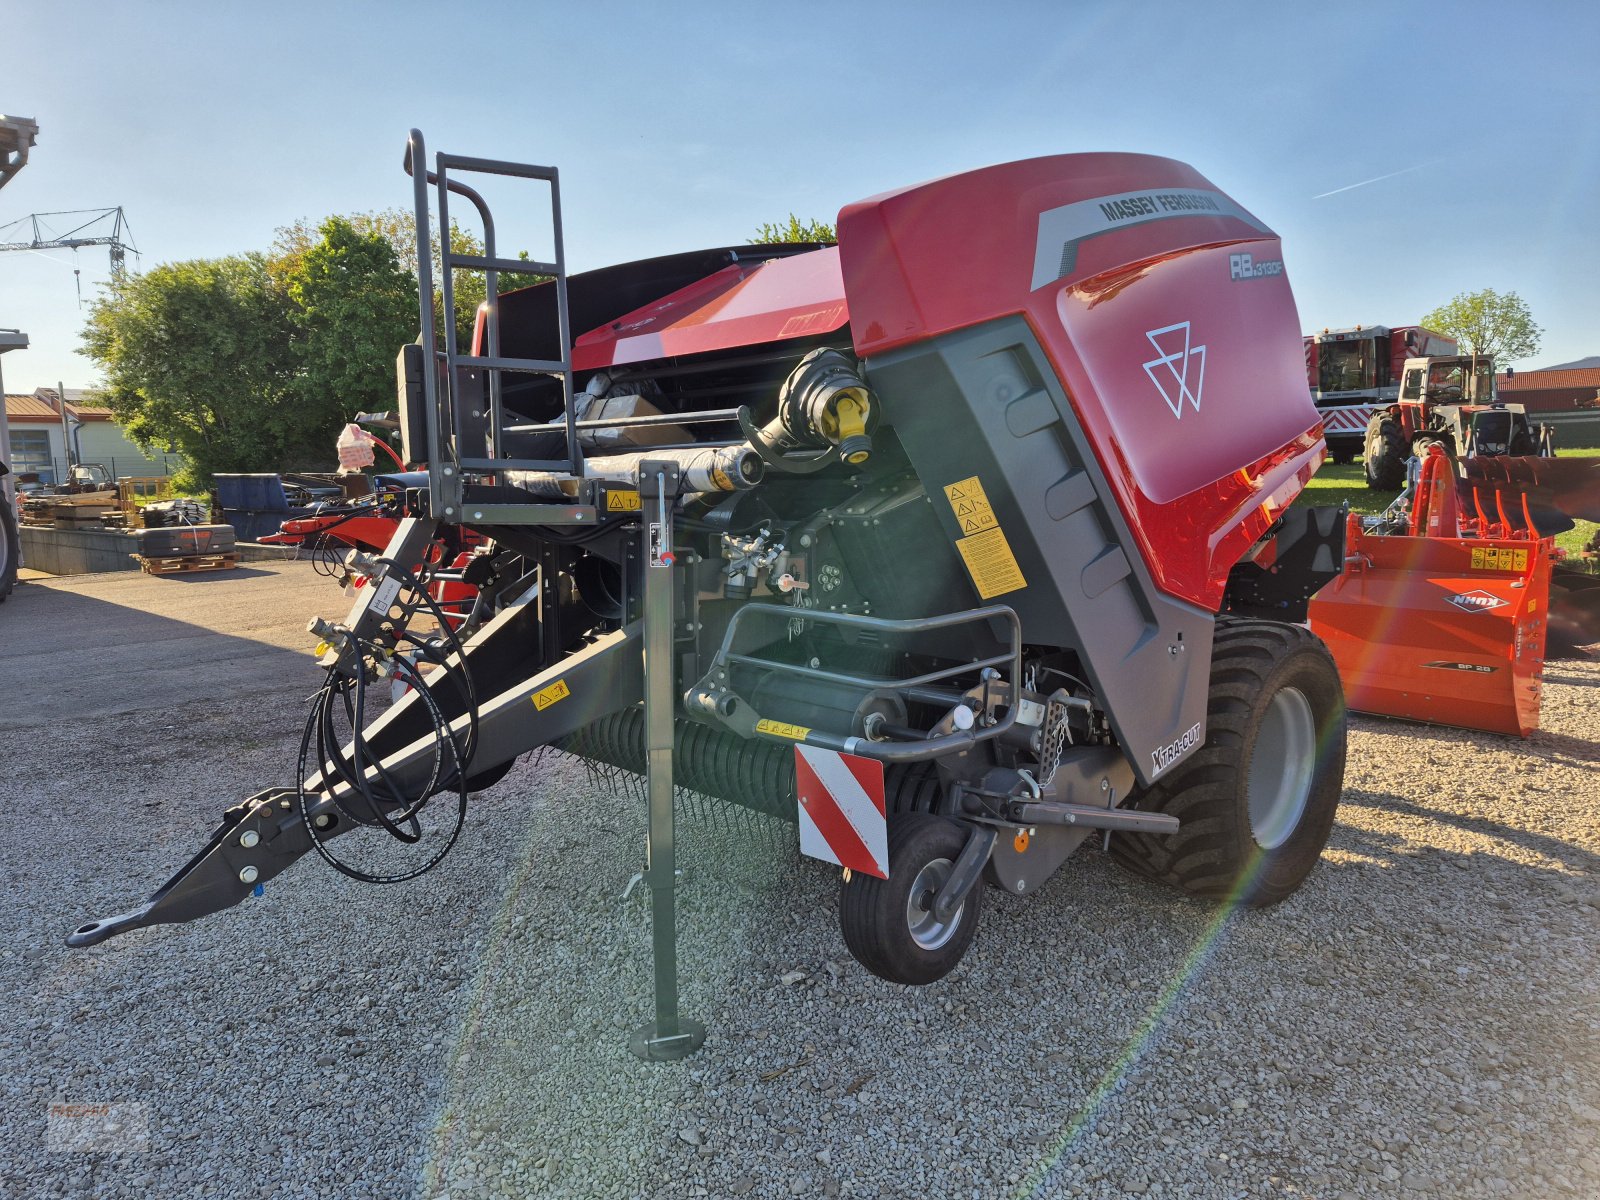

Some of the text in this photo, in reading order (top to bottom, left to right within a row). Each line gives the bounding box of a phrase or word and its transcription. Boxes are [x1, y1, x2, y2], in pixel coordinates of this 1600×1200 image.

[1099, 194, 1219, 221] MASSEY FERGUSON
[1453, 595, 1499, 606] KUHN
